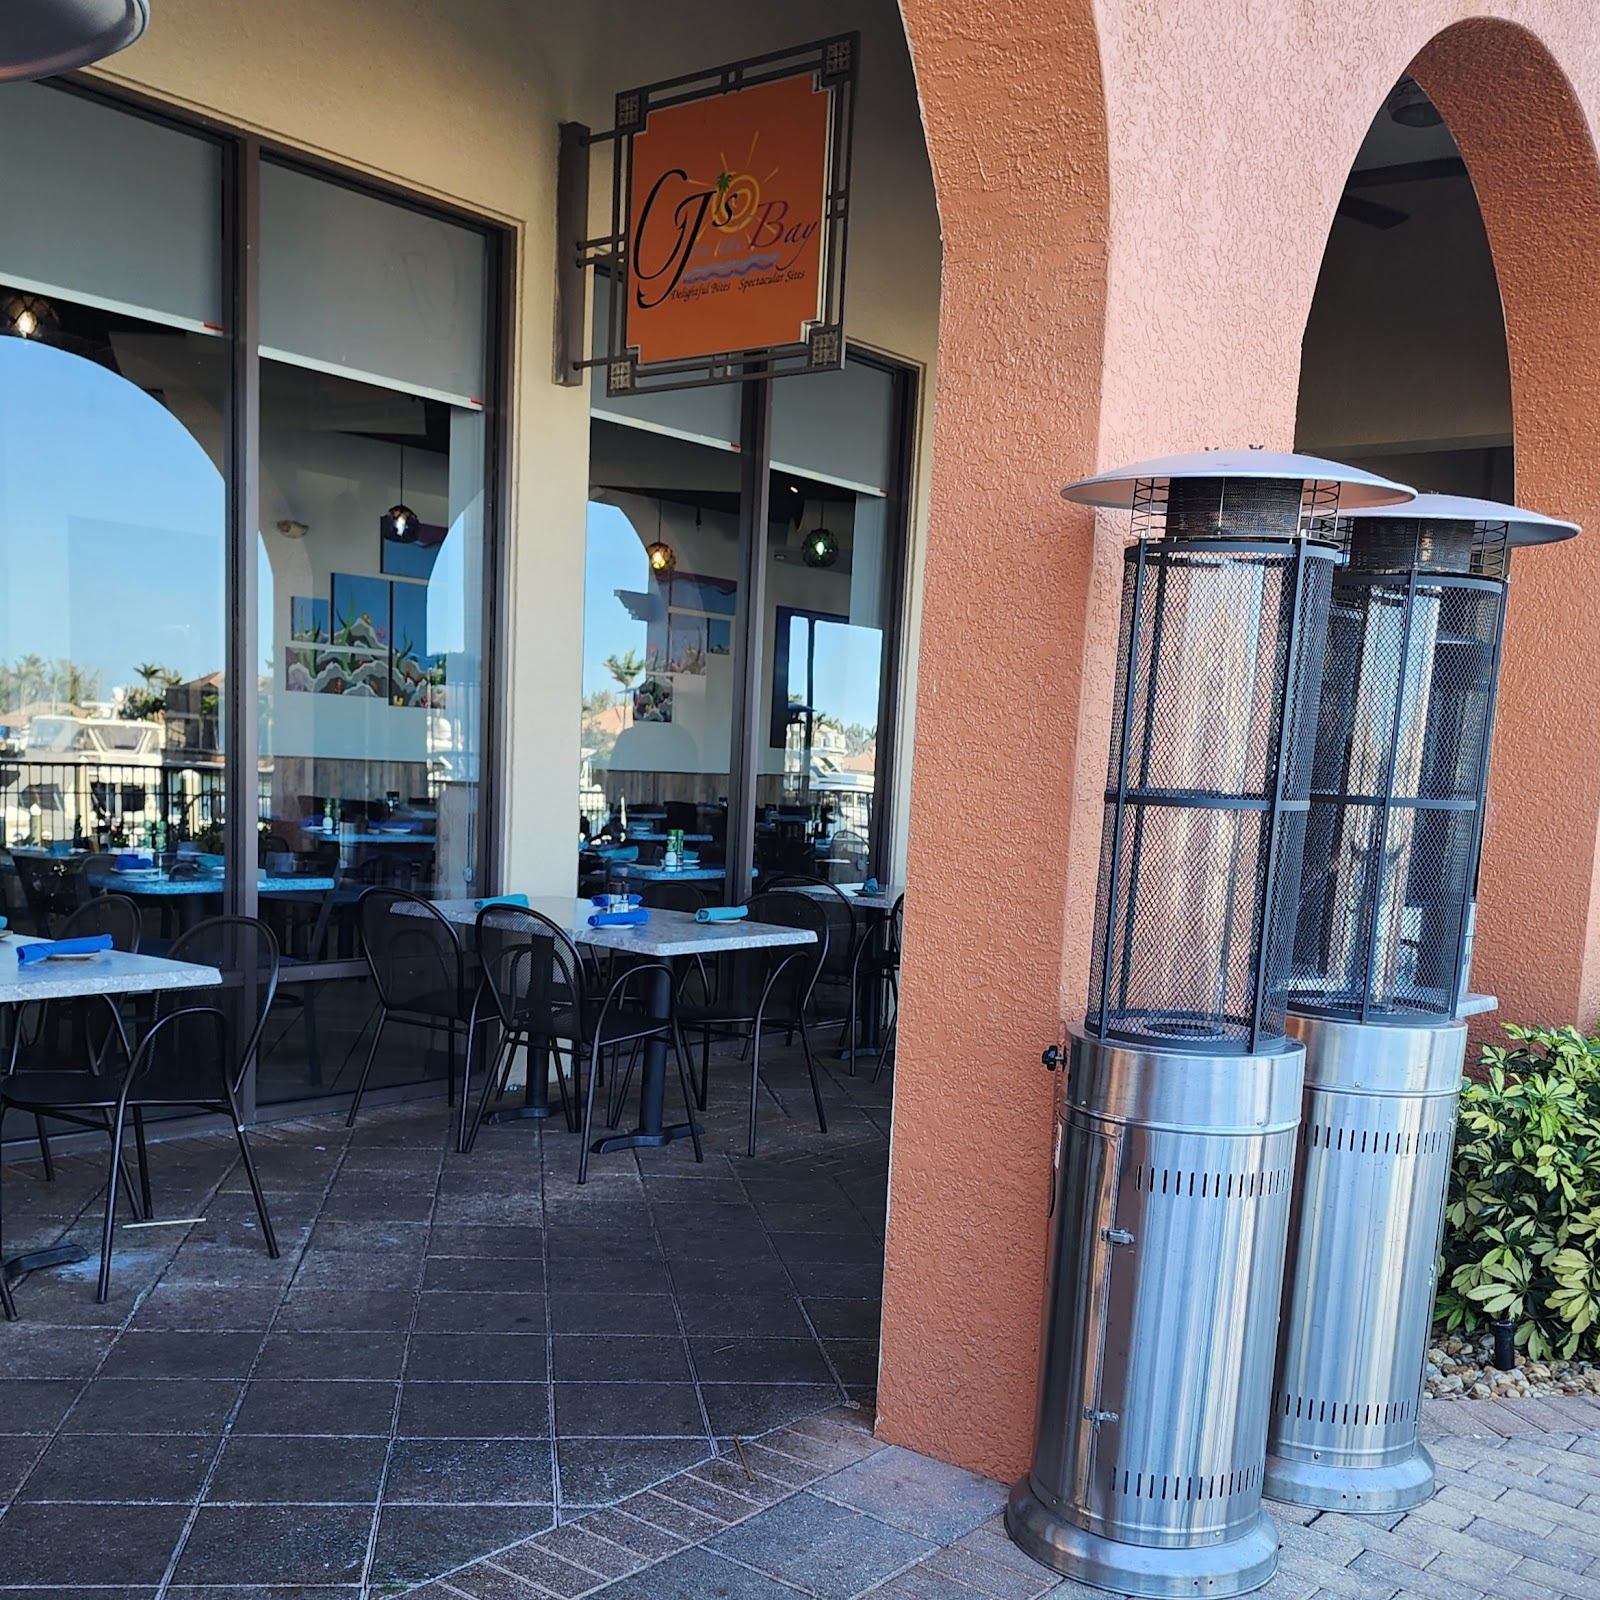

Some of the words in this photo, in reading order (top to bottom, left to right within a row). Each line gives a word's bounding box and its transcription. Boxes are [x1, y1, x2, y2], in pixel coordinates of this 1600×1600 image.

[747, 200, 817, 271] Bay
[671, 283, 709, 302] Delightful
[711, 282, 731, 294] Bites
[738, 272, 783, 293] Spectacular
[785, 269, 805, 283] Sites
